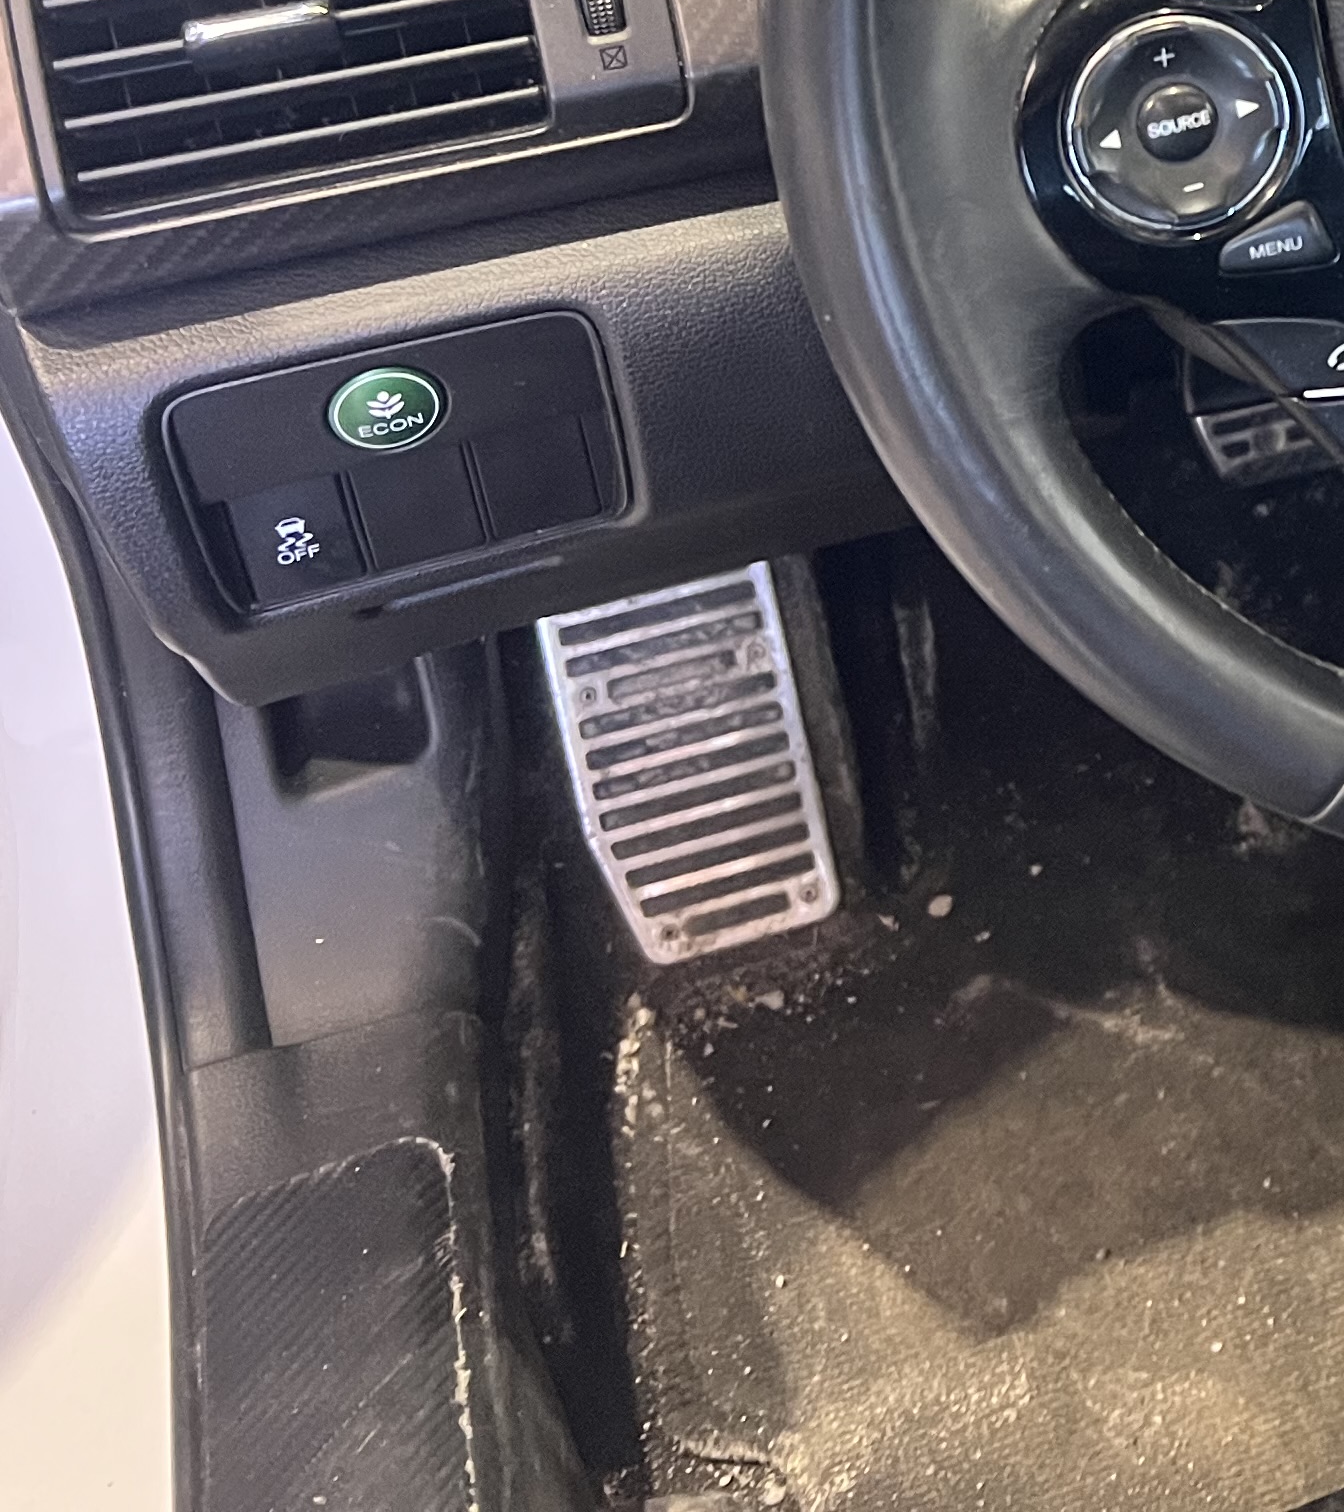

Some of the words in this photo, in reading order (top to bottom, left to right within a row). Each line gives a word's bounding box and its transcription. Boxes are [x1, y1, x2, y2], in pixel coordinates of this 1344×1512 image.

[1147, 109, 1211, 139] SOURCE
[1249, 235, 1303, 260] MENU
[357, 412, 424, 439] ECON
[276, 543, 320, 565] OFF
